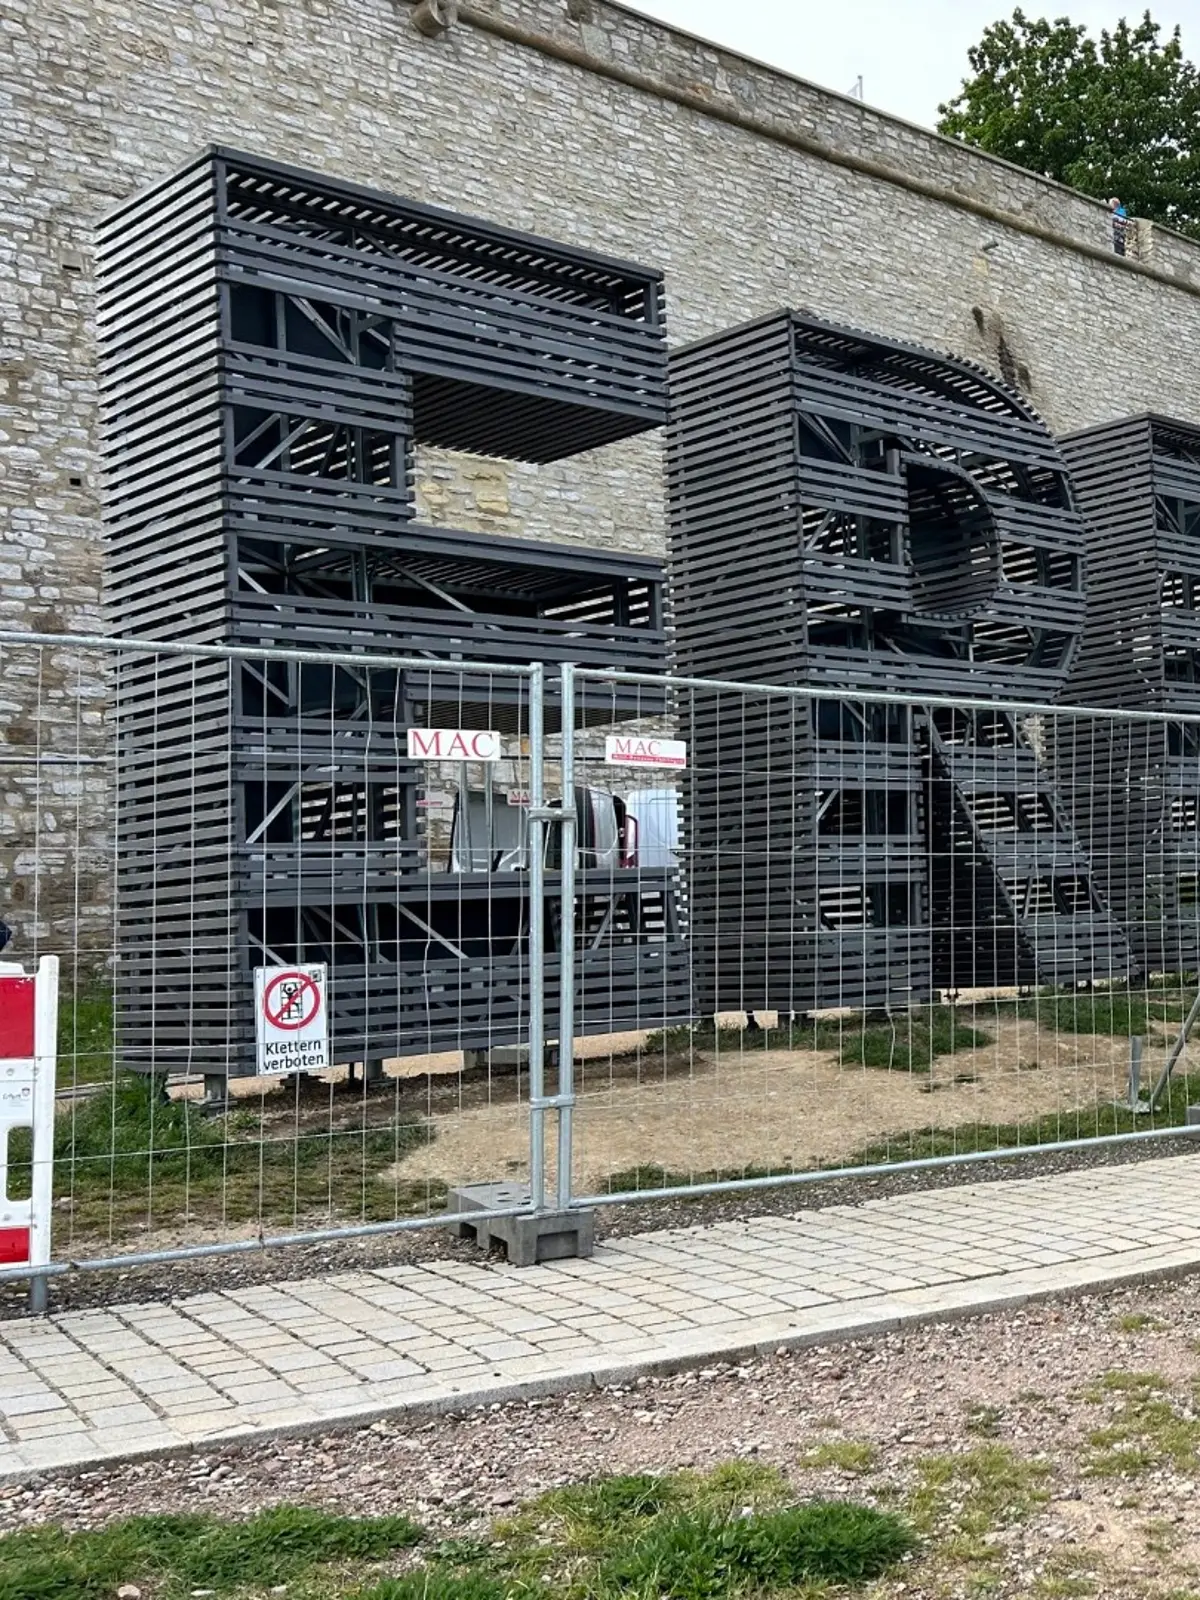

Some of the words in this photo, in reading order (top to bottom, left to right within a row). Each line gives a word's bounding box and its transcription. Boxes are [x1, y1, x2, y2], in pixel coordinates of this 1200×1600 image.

[411, 730, 495, 758] MAC
[615, 738, 662, 756] MAC
[265, 1038, 322, 1056] Klettern
[263, 1053, 325, 1071] verboten
